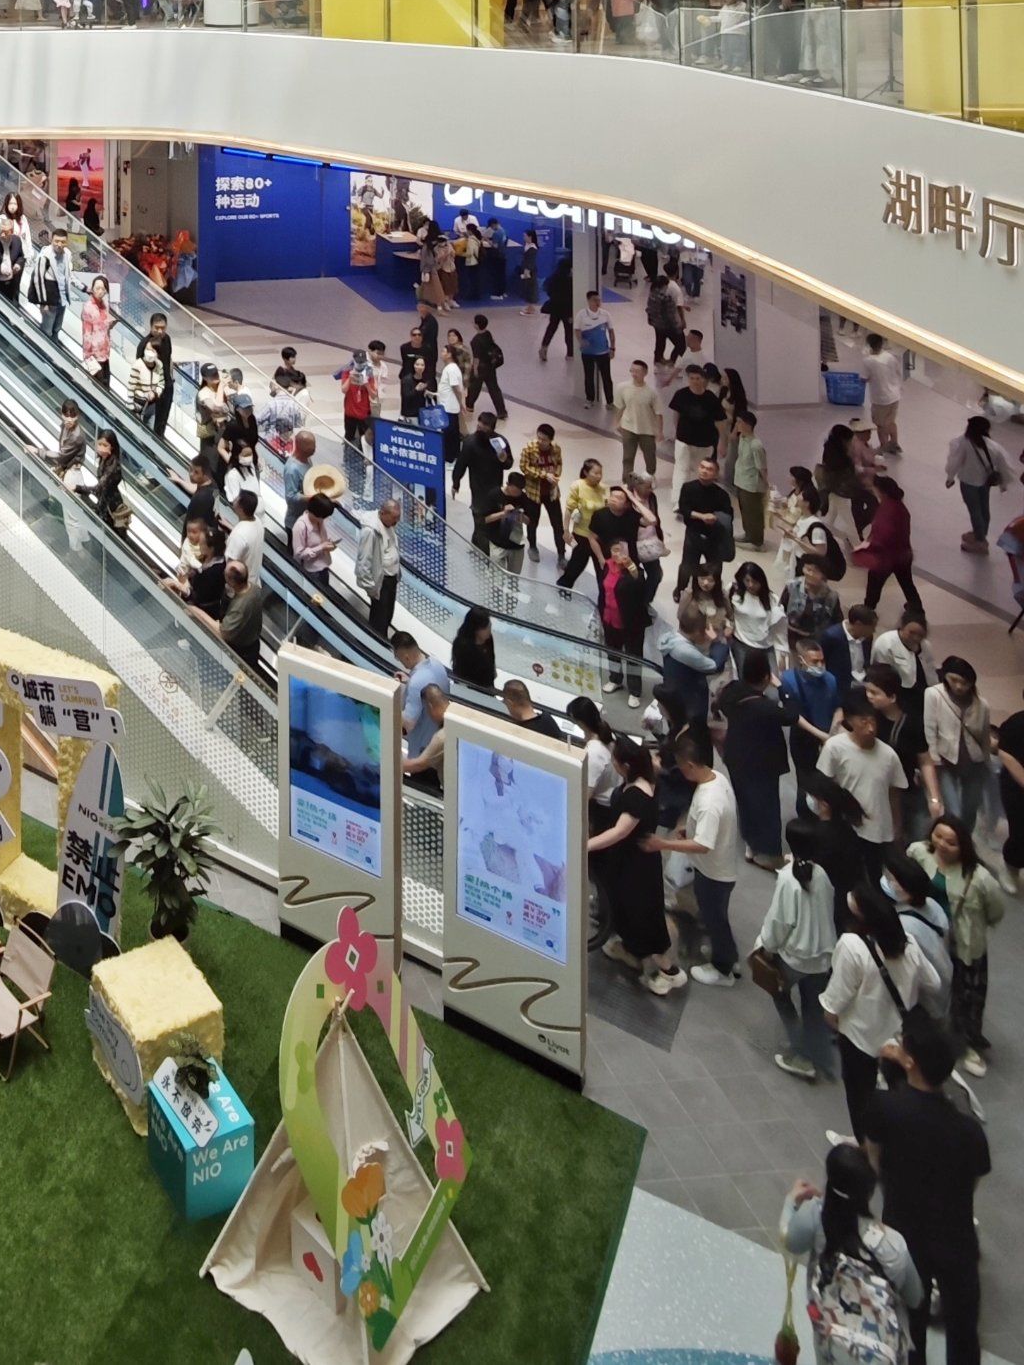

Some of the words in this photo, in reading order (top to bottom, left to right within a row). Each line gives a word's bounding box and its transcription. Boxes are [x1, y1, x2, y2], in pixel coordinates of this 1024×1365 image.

[215, 176, 273, 192] 探索80+
[215, 193, 260, 209] 种运动
[881, 163, 1024, 267] 湖畔厅
[390, 435, 425, 450] HELLO!
[22, 677, 56, 703] 城市
[78, 802, 99, 823] NIO
[65, 829, 120, 894] 禁止
[62, 863, 117, 919] EMO
[217, 1095, 241, 1123] Are
[192, 1149, 219, 1167] We
[222, 1134, 250, 1156] Are
[192, 1162, 223, 1187] NIO
